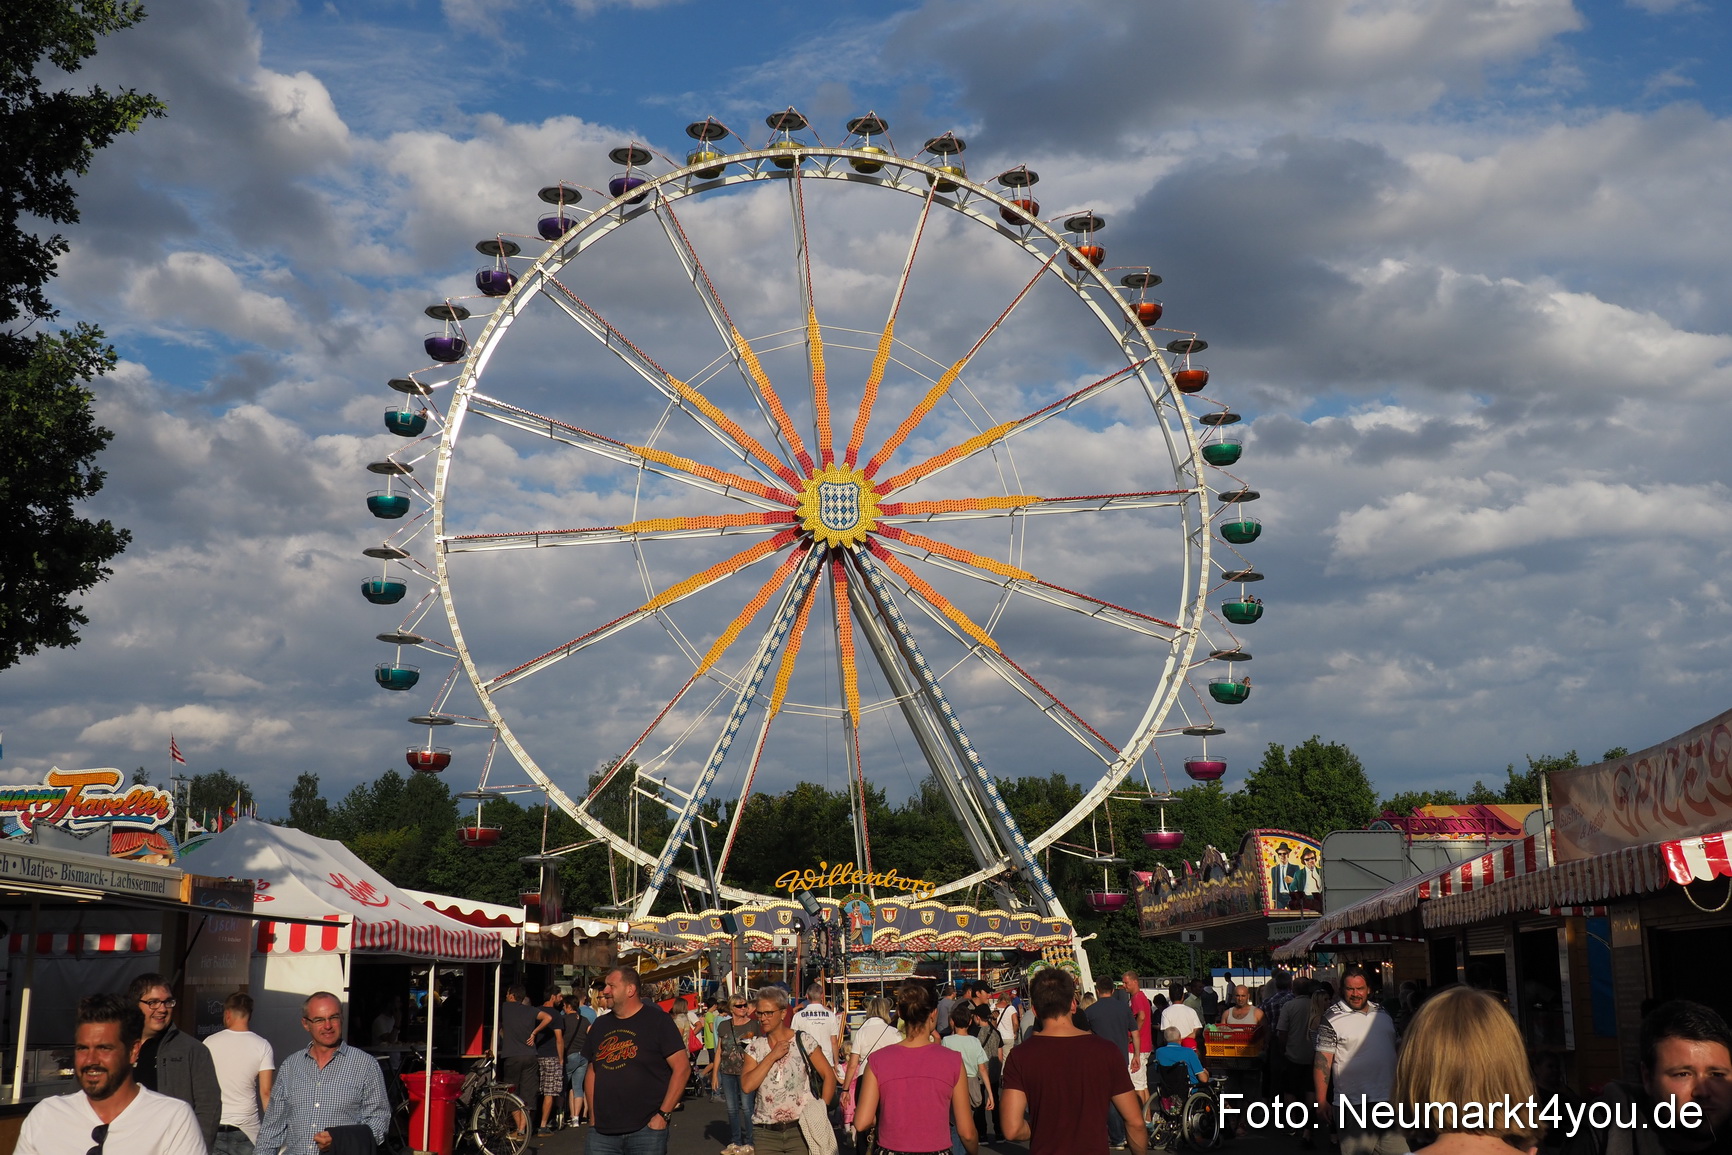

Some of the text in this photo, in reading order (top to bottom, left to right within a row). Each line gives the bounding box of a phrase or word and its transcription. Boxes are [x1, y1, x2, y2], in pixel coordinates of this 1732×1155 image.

[21, 771, 170, 827] Traveller
[19, 857, 58, 881] Matjes-
[61, 863, 108, 886] Bismarck-
[110, 871, 166, 894] Lachssemmel
[775, 861, 936, 899] Willenborg
